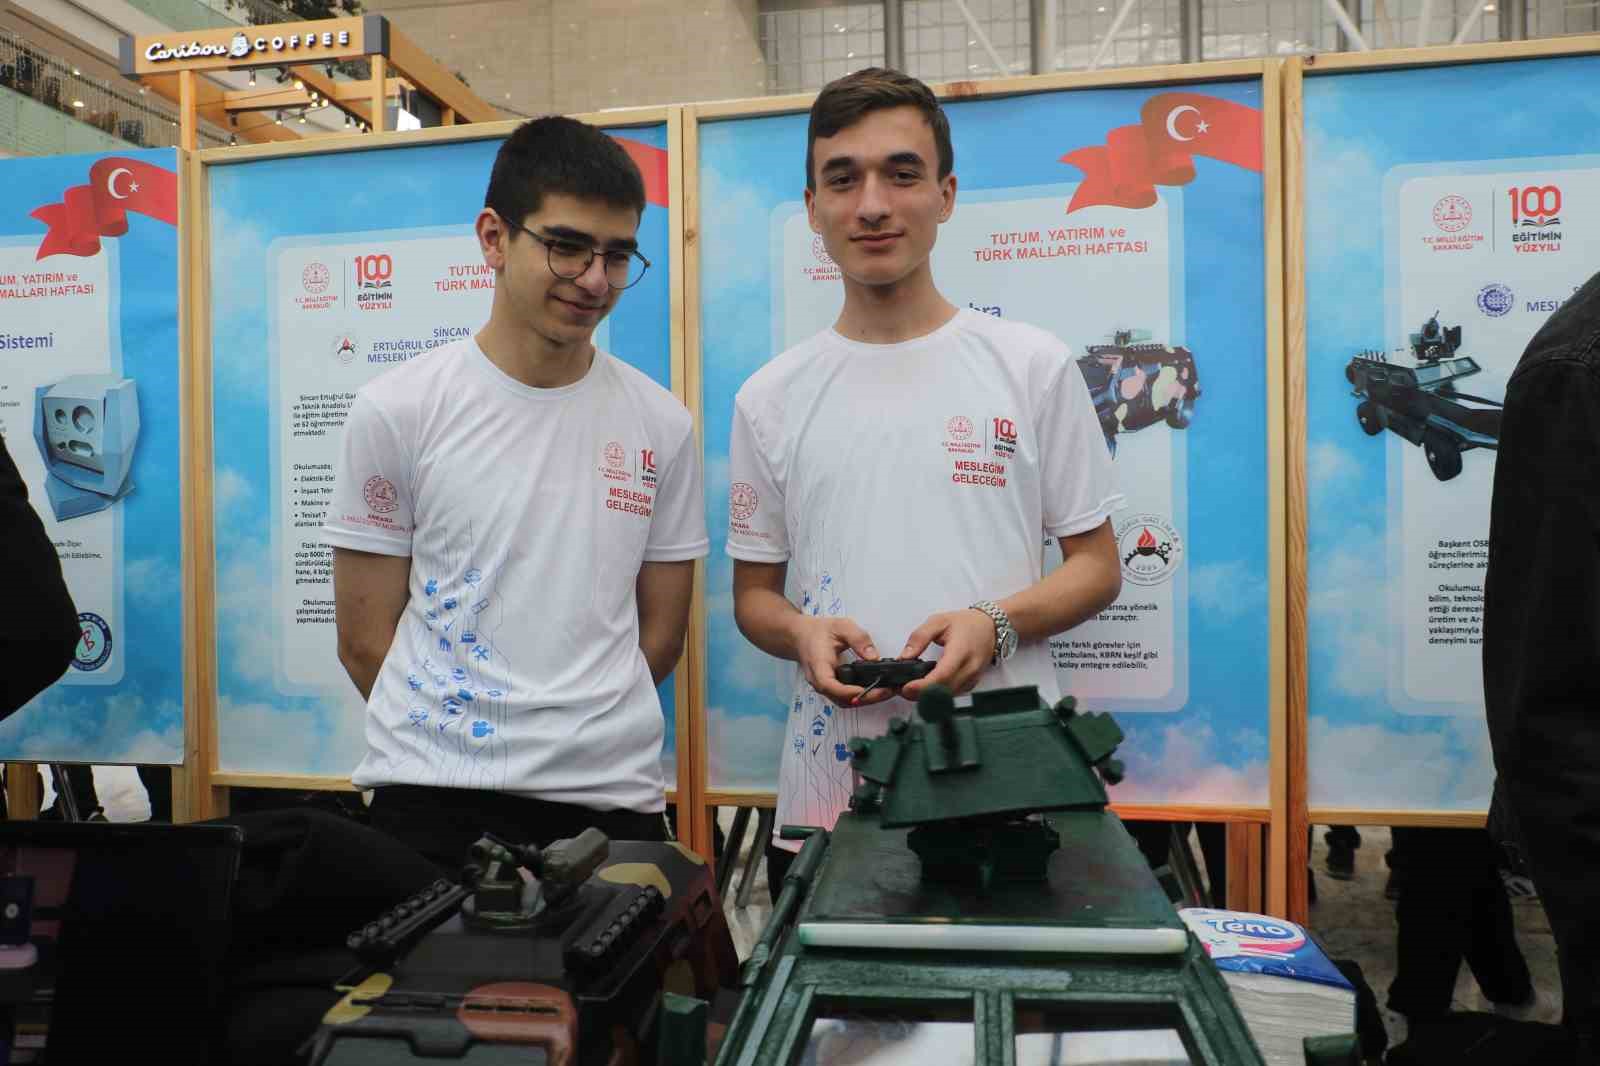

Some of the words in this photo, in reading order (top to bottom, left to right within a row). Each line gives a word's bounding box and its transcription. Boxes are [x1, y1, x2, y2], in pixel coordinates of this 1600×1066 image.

[145, 41, 226, 61] Caribou
[254, 31, 349, 51] COFFEE
[1508, 185, 1562, 226] 100
[990, 231, 1043, 245] TUTUM,
[1047, 227, 1104, 240] YATIRIM
[1109, 229, 1126, 237] ve
[1512, 231, 1561, 242] EĞİTİMİN
[974, 247, 1012, 262] TÜRK
[1017, 244, 1081, 259] MALLARI
[1086, 241, 1148, 255] HAFTASI
[1514, 243, 1561, 252] YÜZYILI
[66, 272, 78, 281] ve
[354, 254, 392, 288] 100
[434, 279, 466, 292] TÜRK
[470, 278, 495, 290] MAL
[1526, 301, 1559, 313] MESL
[433, 327, 470, 338] SİNCAN
[0, 332, 54, 350] Sistemi
[373, 338, 423, 352] ERTUĞRUL
[367, 350, 407, 363] MESLEKİ
[955, 460, 1004, 475] MESLEĞİM
[952, 472, 1007, 488] GELECEĞİM
[609, 487, 652, 505] MESLEĞİM
[606, 499, 652, 517] GELECEĞİM
[1206, 919, 1287, 935] Teno
